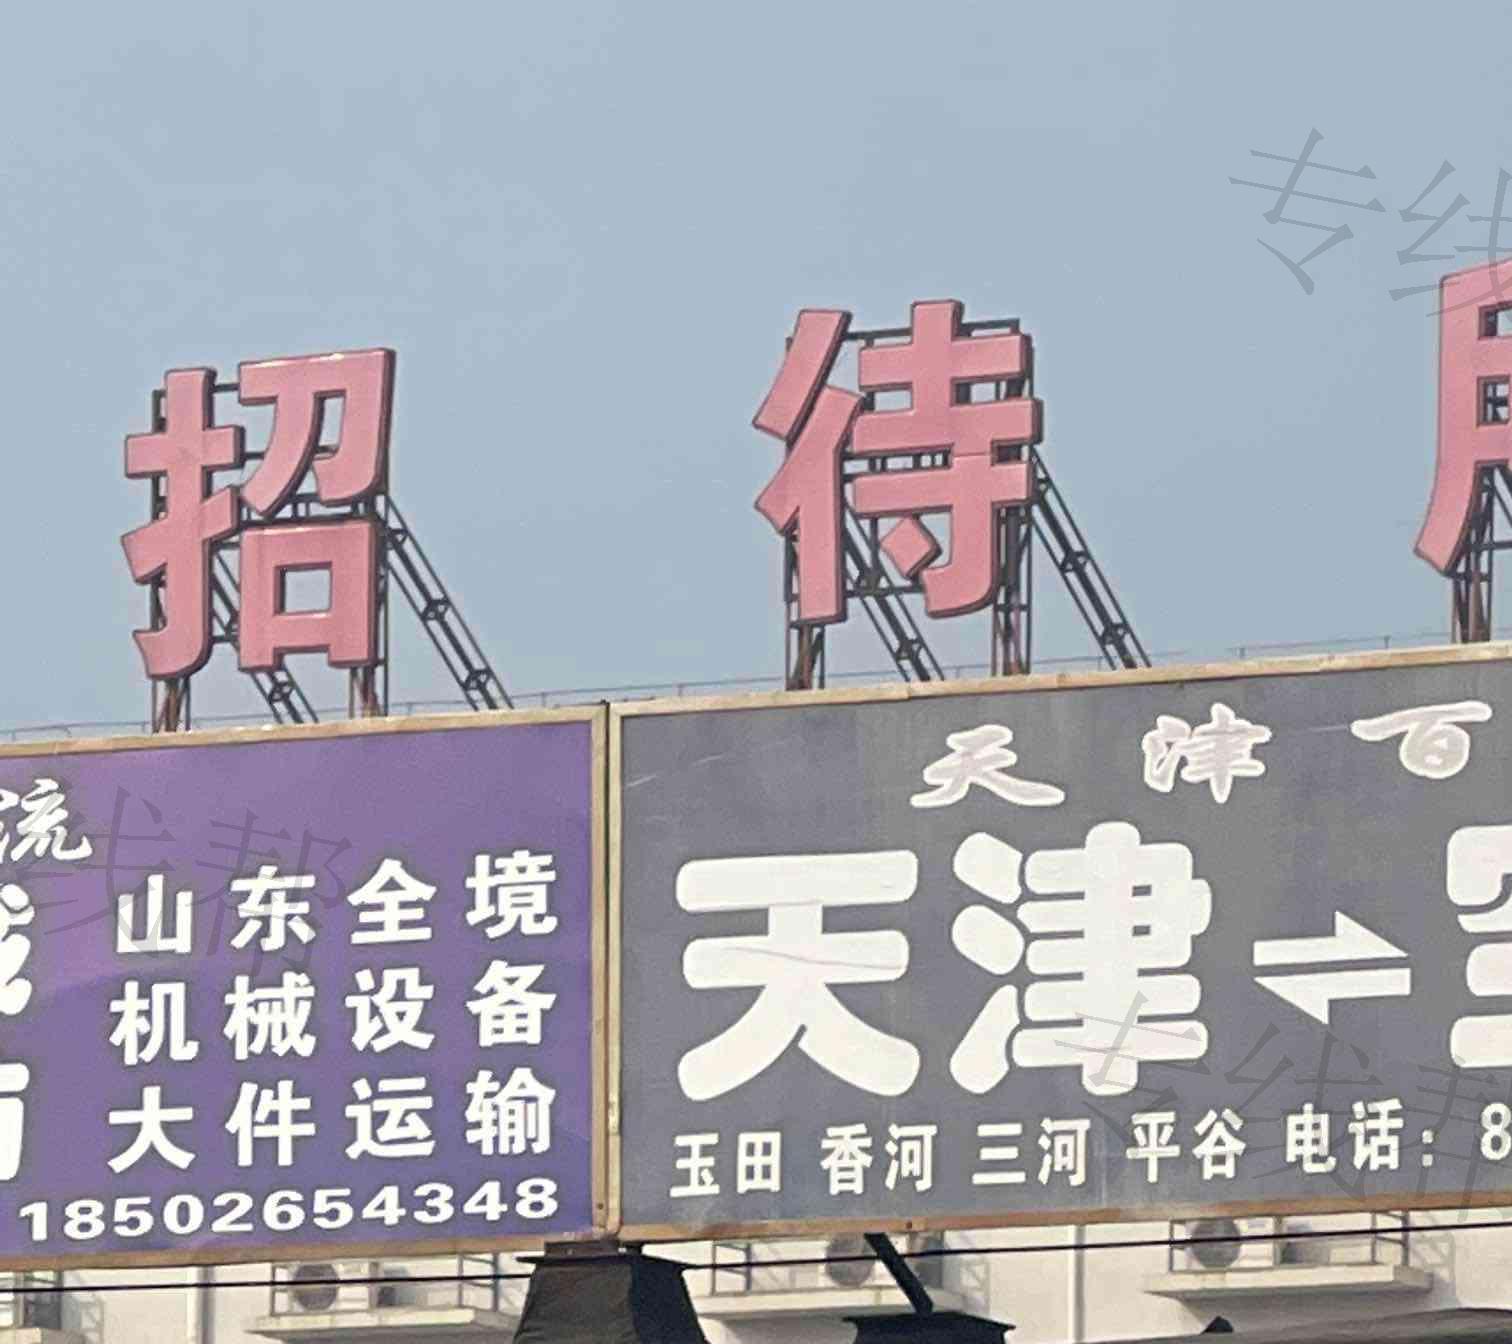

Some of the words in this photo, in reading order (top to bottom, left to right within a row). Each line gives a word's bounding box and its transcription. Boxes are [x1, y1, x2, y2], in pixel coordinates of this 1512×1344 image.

[115, 850, 559, 956] 山东全境
[109, 960, 558, 1067] 机械设备
[675, 820, 1213, 1102] 天津
[108, 1067, 557, 1174] 大件运输
[669, 1131, 783, 1199] 玉田
[819, 1122, 938, 1196] 香河
[971, 1117, 1092, 1188] 三河
[1126, 1107, 1247, 1183] 平谷
[19, 1178, 560, 1242] 18502654348
